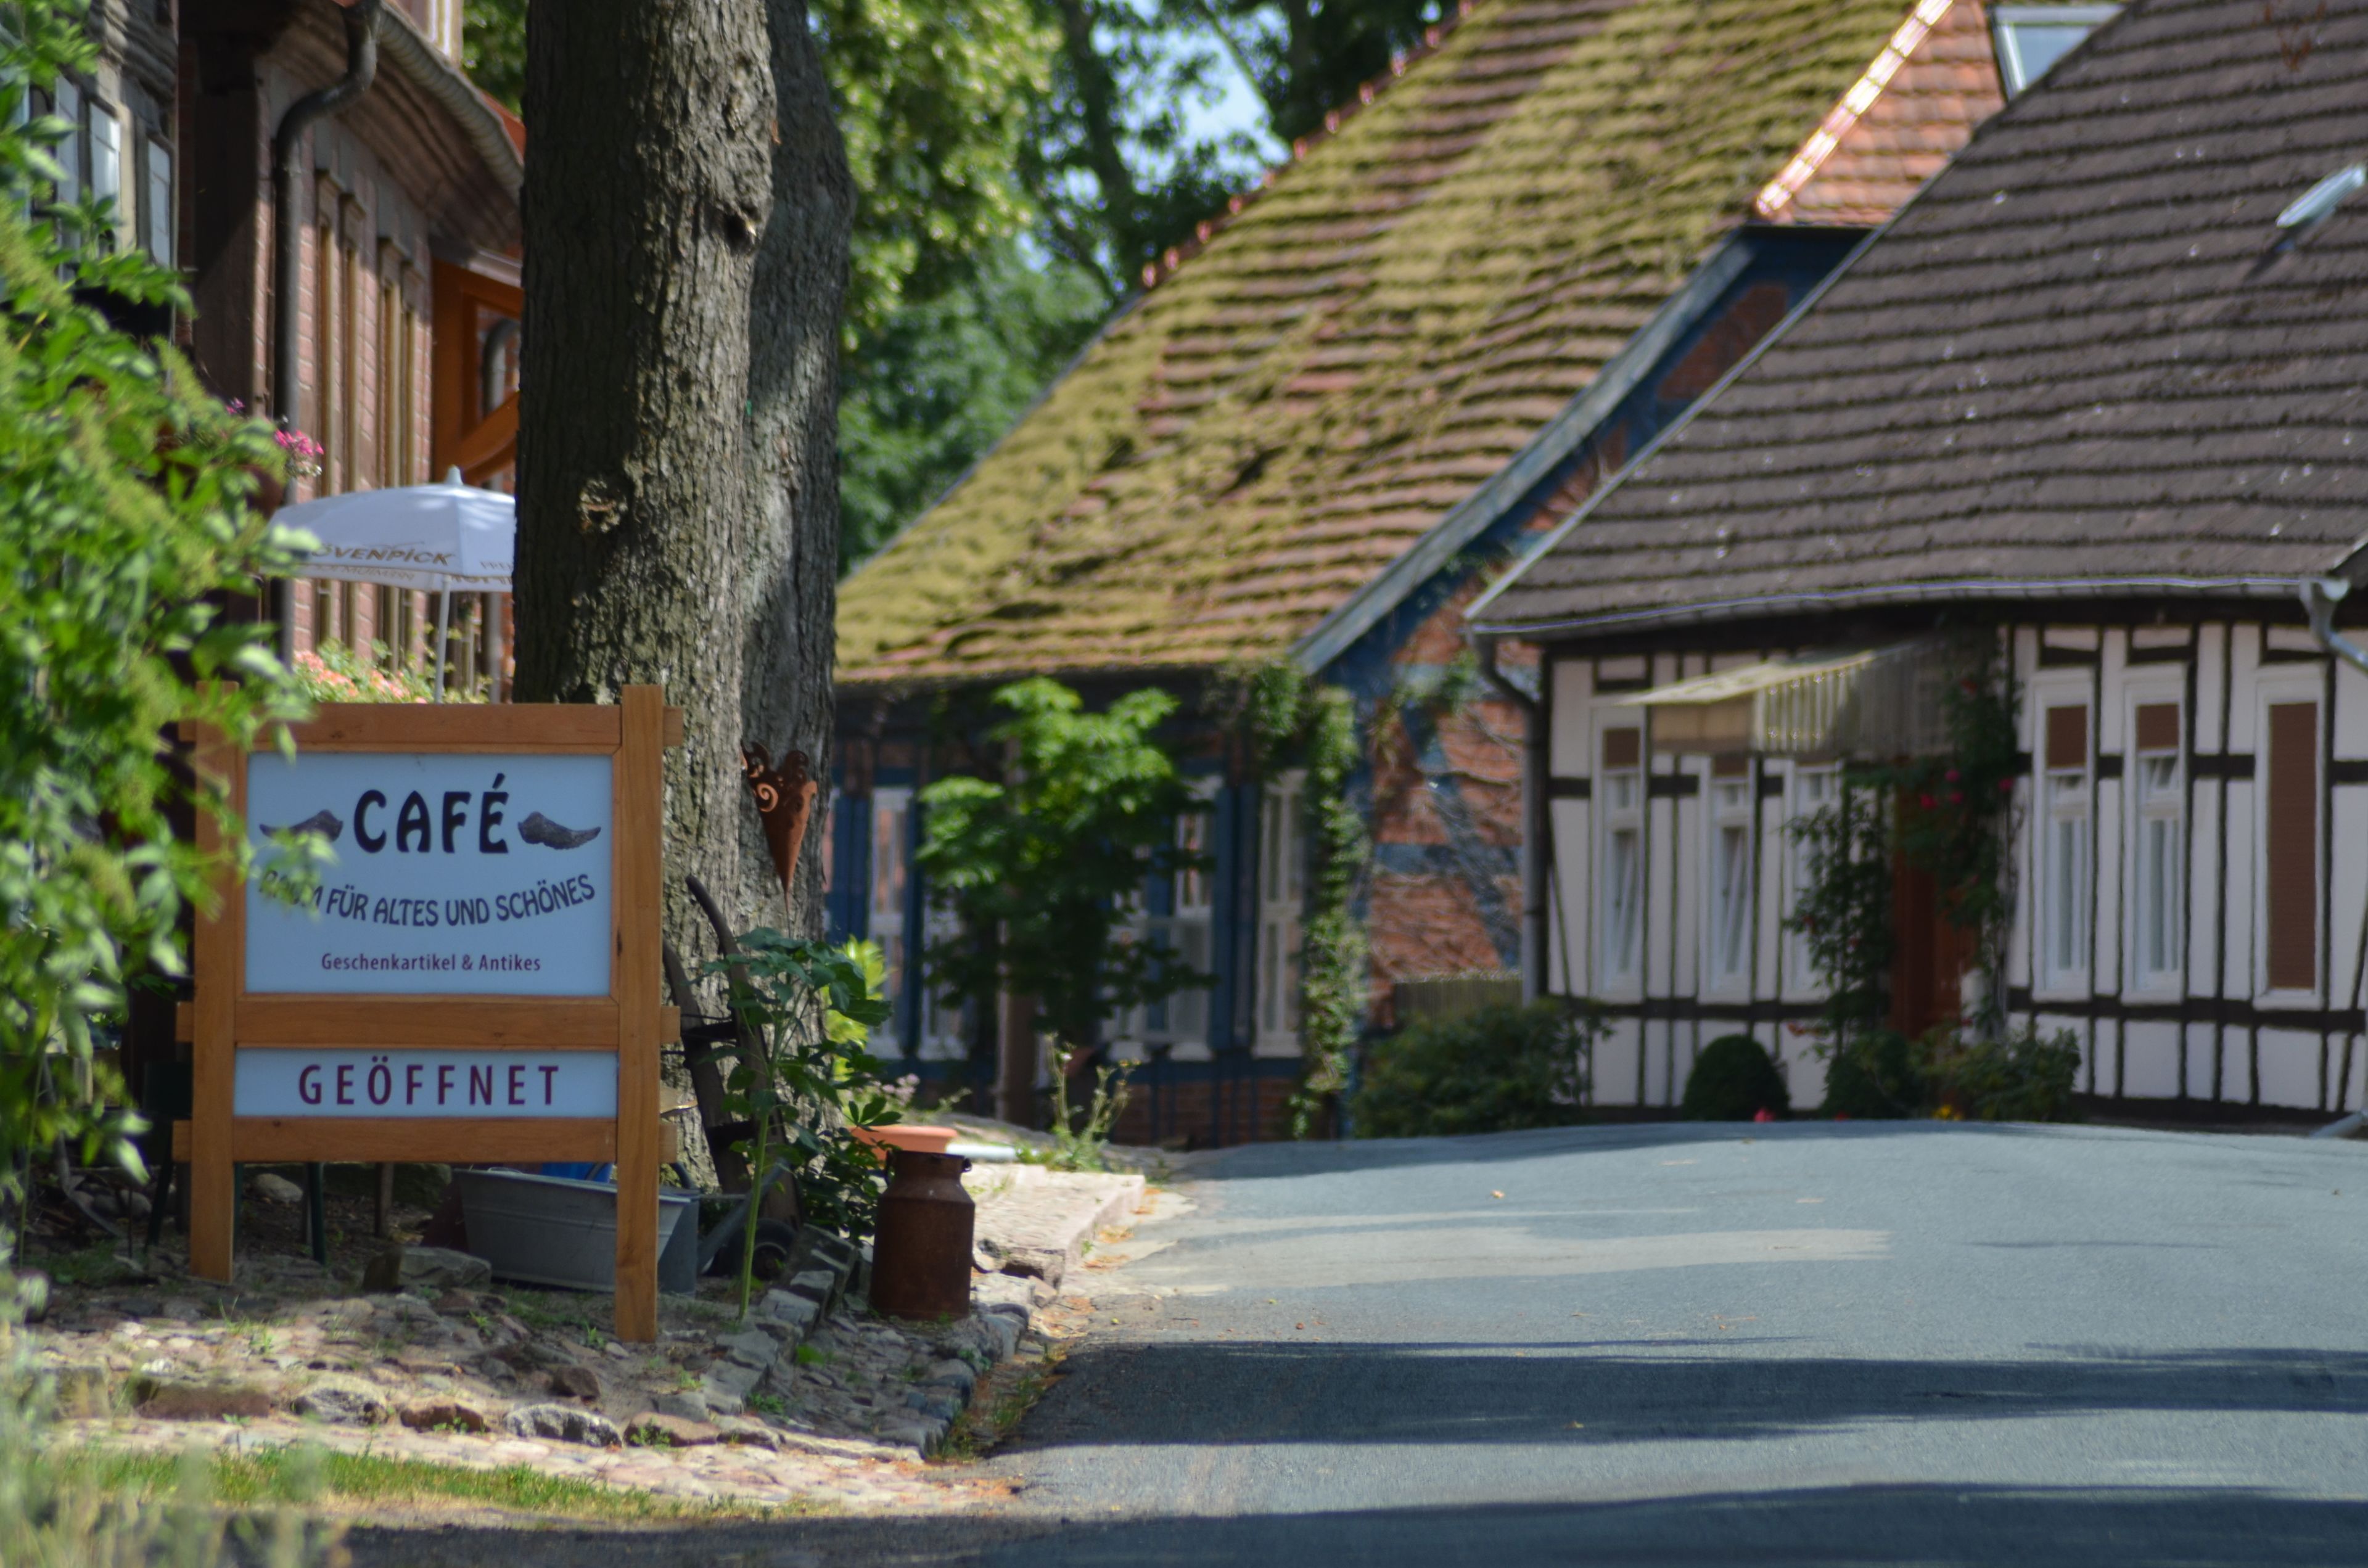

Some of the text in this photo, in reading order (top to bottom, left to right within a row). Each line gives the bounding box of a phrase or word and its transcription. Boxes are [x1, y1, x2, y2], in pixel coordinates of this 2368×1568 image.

[353, 773, 509, 854] CAFÉ
[326, 884, 368, 921] FÜR
[374, 898, 438, 927] ALTES
[446, 898, 490, 926] UND
[495, 874, 595, 921] SCHÖNES
[321, 953, 541, 971] Geschenkartikel & Antikes
[298, 1056, 559, 1105] GEÖFFNET
